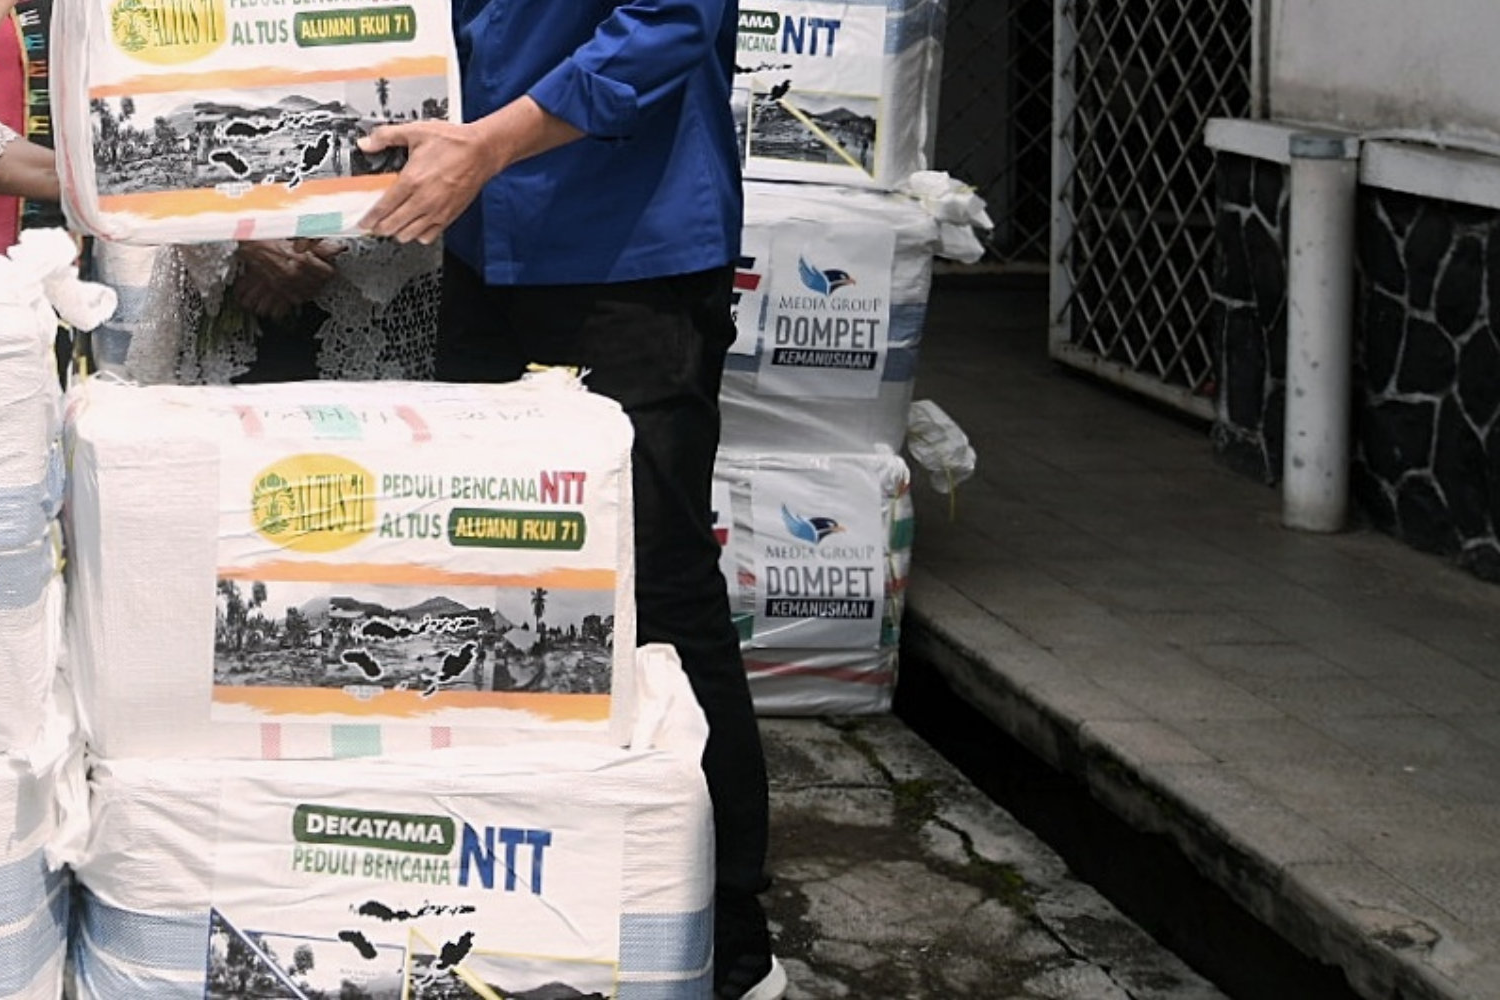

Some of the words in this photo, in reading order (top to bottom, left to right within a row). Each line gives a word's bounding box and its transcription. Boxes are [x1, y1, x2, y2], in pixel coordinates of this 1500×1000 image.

[231, 19, 289, 47] ALTUS
[301, 16, 356, 40] ALUMNI
[360, 15, 390, 37] FKUI
[394, 15, 410, 34] 71
[737, 34, 778, 52] NCANA
[781, 15, 841, 58] NTT
[778, 295, 827, 311] MEDIA
[830, 297, 882, 313] GROUP
[775, 315, 880, 349] DOMPET
[777, 350, 872, 369] KEMANUSIAAN
[295, 475, 344, 533] ALTUS
[383, 473, 444, 500] PEDULI
[451, 475, 538, 502] BENCANA
[539, 470, 587, 505] NTT
[380, 511, 442, 539] ALTUS
[455, 516, 516, 540] ALUMNI
[522, 518, 556, 541] FKUI
[560, 519, 579, 541] 71
[765, 545, 816, 560] MEDIA
[820, 545, 875, 561] GROUP
[765, 565, 874, 598] DOMPET
[771, 601, 868, 617] KEMANUSIAAN
[305, 812, 445, 845] DEKATAMA
[292, 846, 356, 876] PEDULI
[362, 854, 450, 886] BENCANA
[457, 821, 552, 896] NTT
